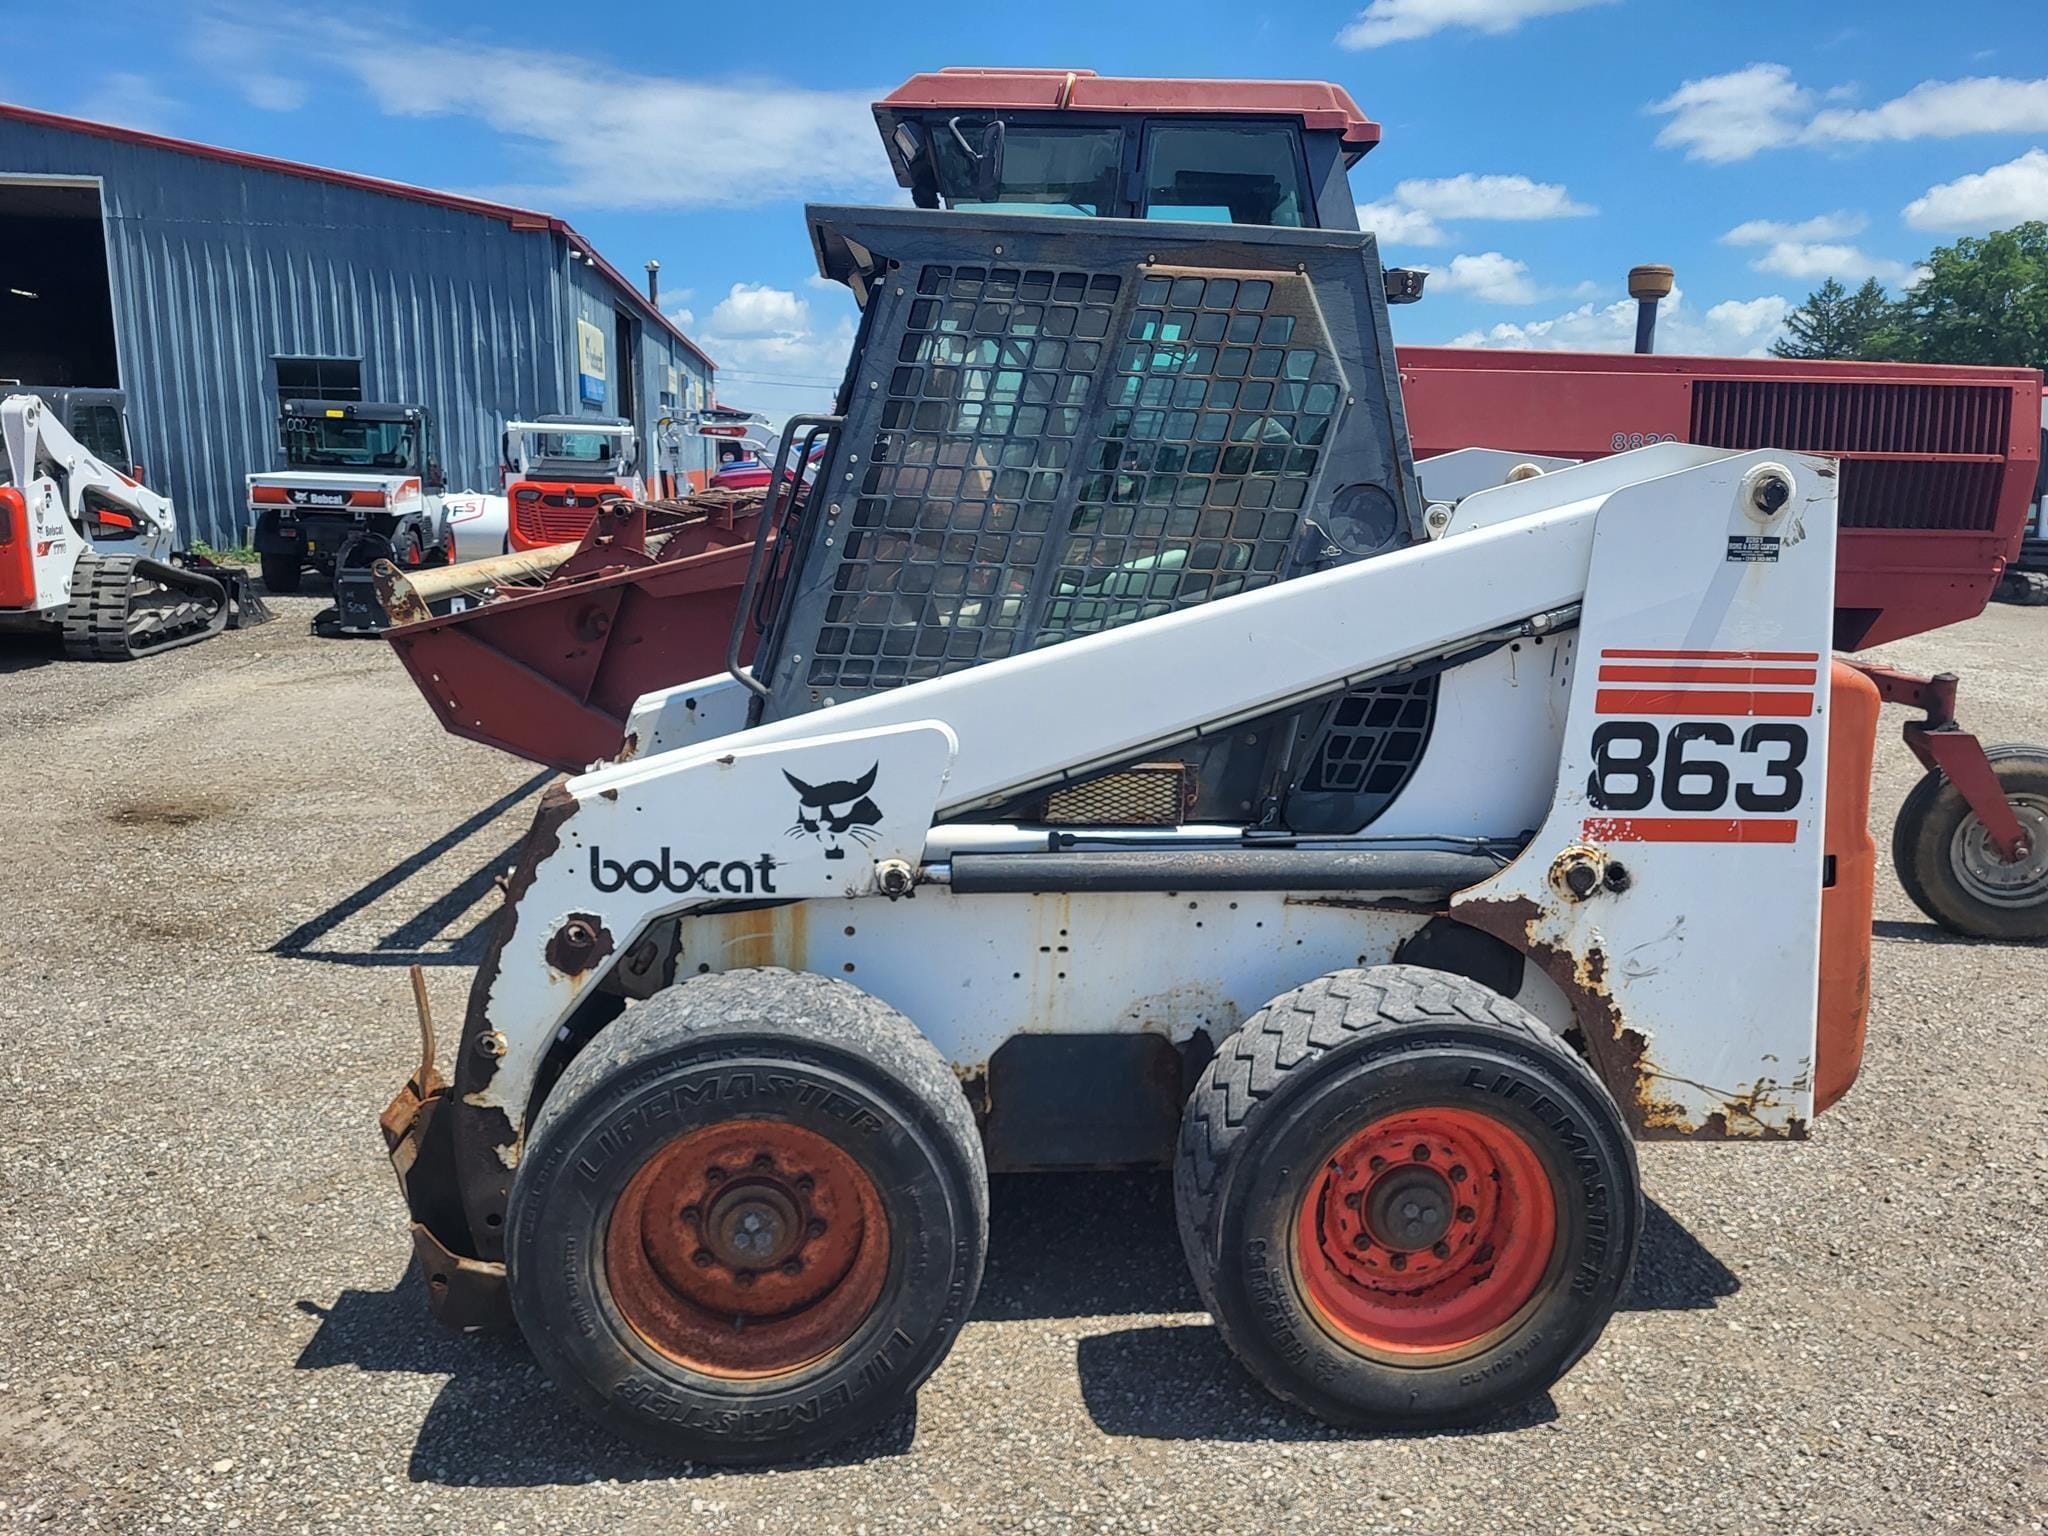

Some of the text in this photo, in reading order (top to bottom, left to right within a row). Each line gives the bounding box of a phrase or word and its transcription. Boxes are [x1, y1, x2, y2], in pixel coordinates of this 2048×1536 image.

[310, 493, 343, 505] Bobcat
[1586, 720, 1809, 812] 863
[590, 846, 776, 893] bobcat
[577, 1071, 887, 1184] LIFEMASTER
[1463, 1066, 1612, 1297] LIFEMASTER
[612, 1326, 915, 1437] LIFEMASTER
